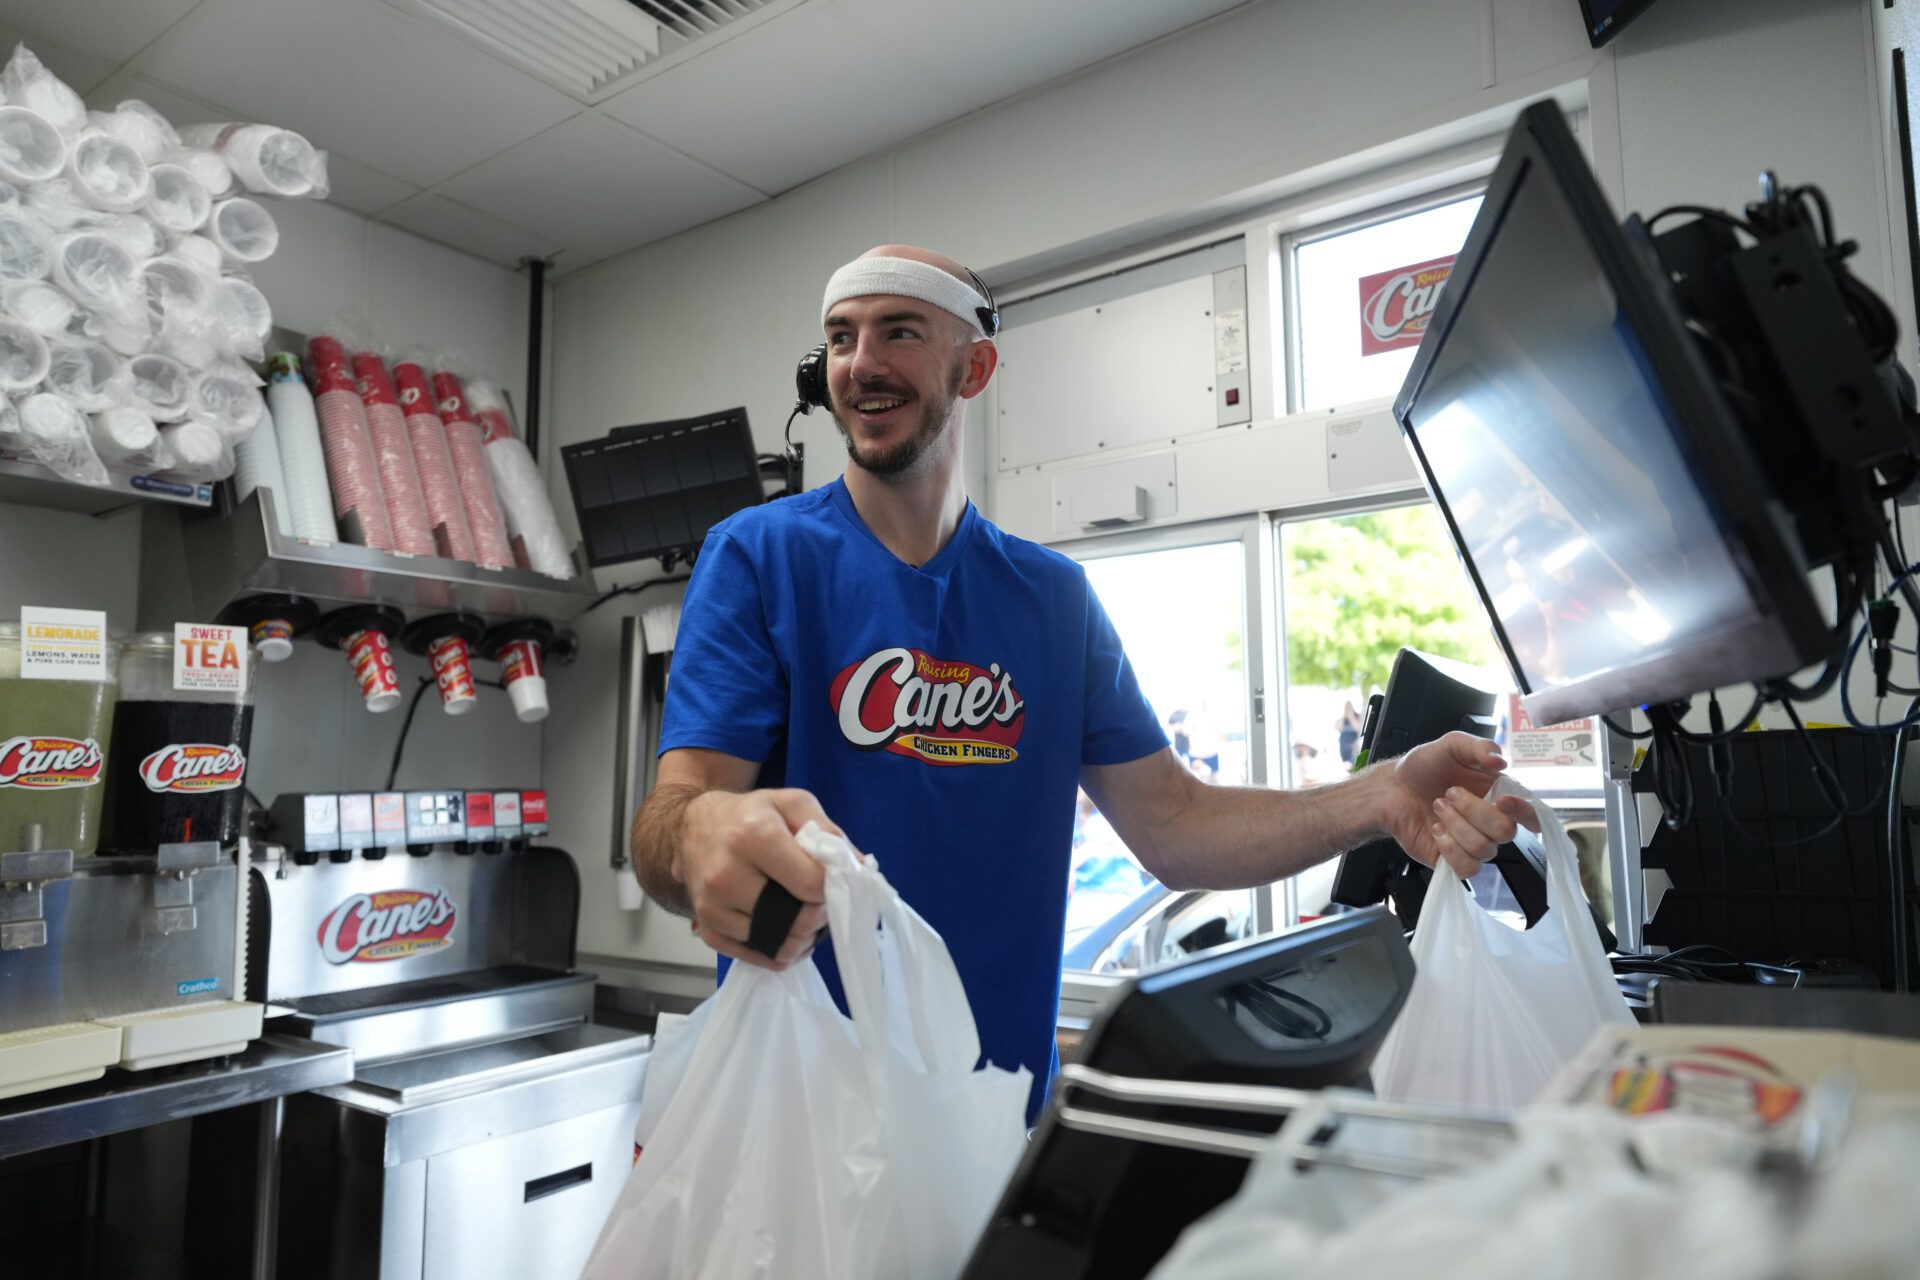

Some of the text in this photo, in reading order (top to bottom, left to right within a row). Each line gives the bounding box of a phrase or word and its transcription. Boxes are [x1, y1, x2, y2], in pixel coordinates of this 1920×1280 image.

[26, 624, 101, 641] LEMONADE
[191, 627, 232, 640] SWEET
[26, 650, 101, 660] LEMONS, WATER
[180, 639, 240, 670] TEA
[917, 654, 970, 683] Raising
[838, 647, 1025, 748] Cane's
[0, 736, 101, 785] Cane's
[913, 736, 1011, 760] CHICKEN FINGERS
[146, 744, 241, 789] Cane's
[322, 886, 455, 966] Cane's
[179, 981, 218, 994] Crathco
